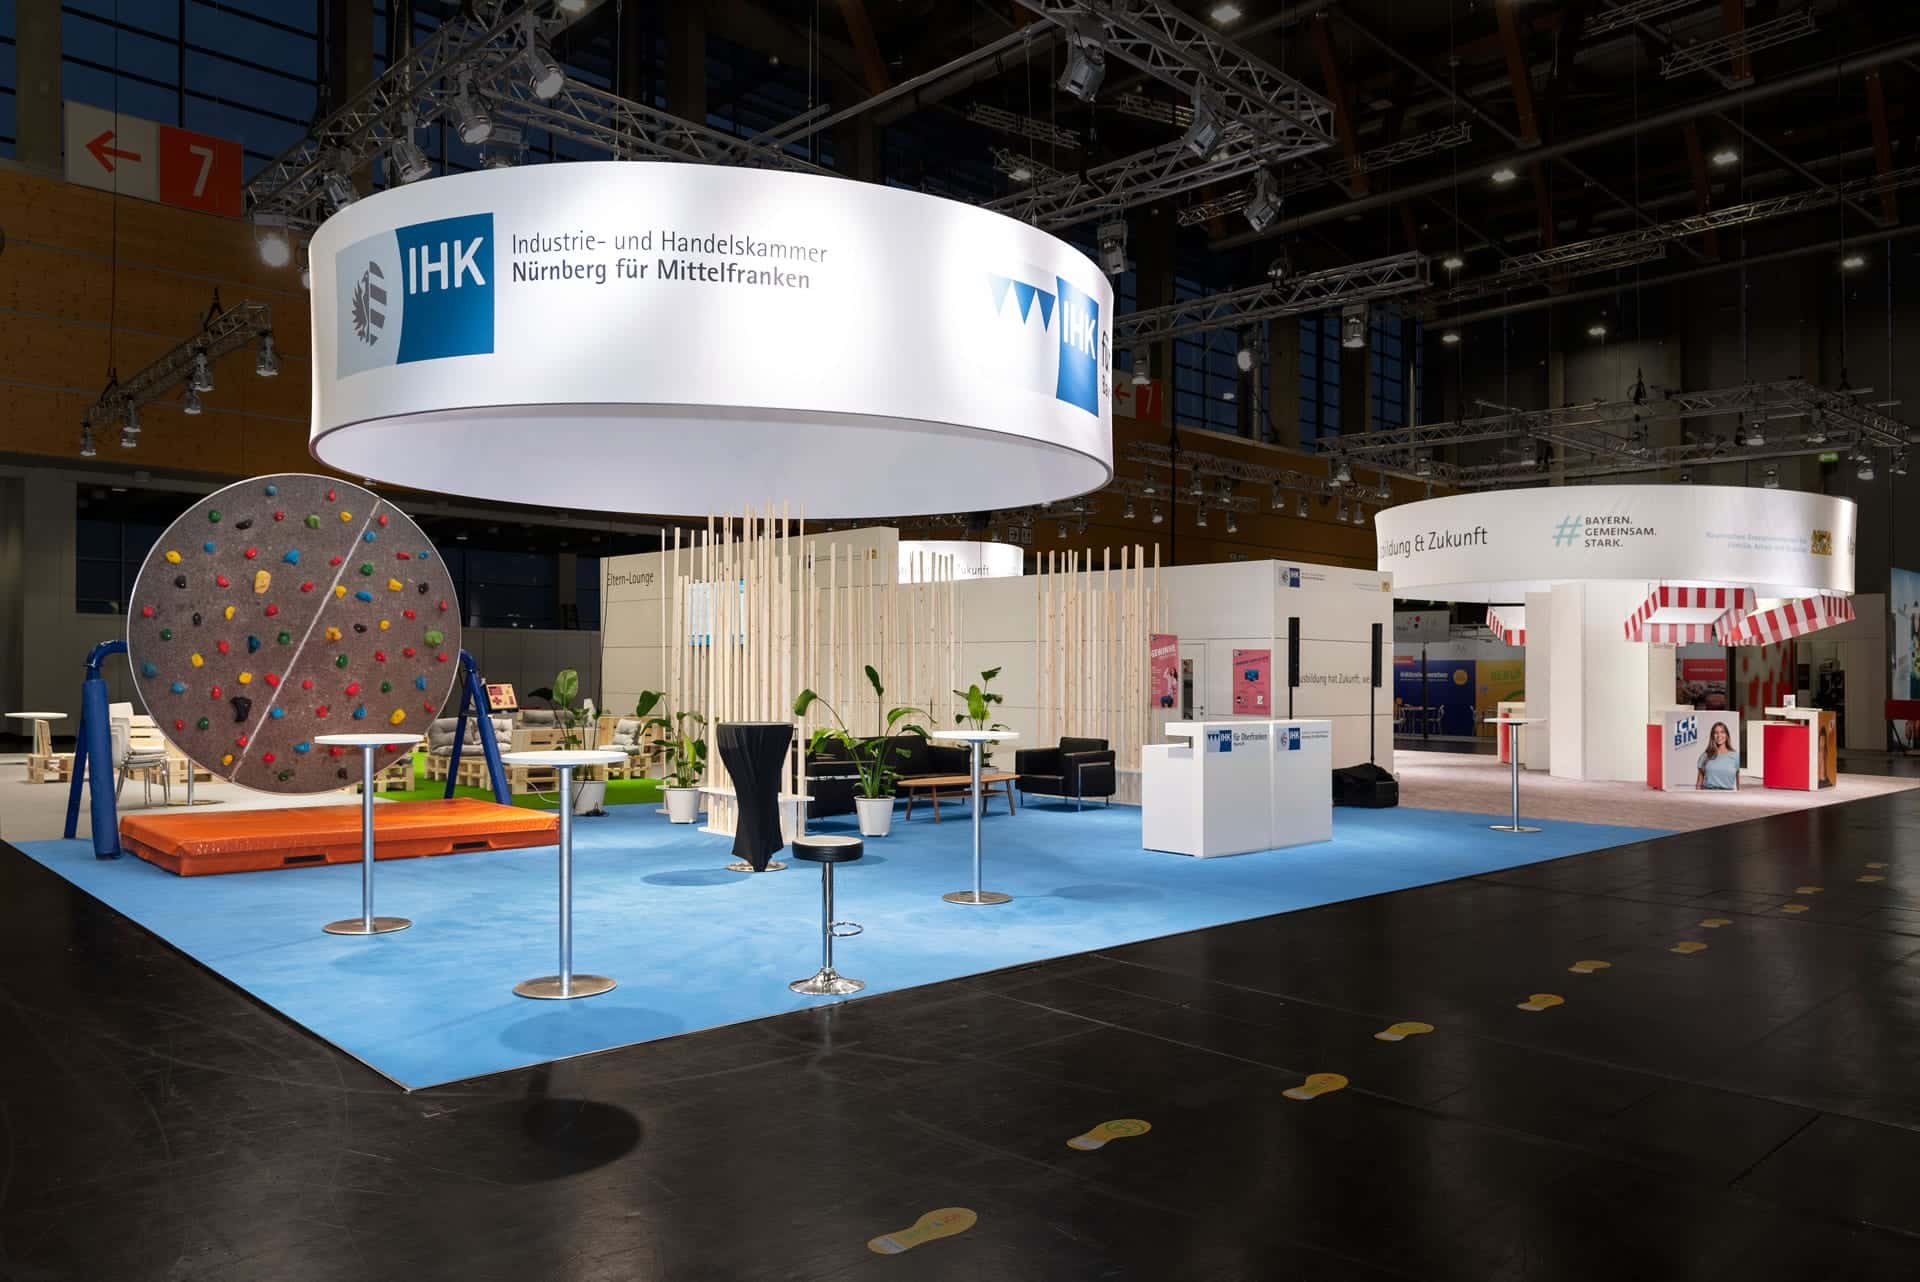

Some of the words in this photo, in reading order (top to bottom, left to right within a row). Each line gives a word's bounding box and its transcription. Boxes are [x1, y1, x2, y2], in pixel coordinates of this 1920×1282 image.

[189, 145, 216, 198] 7
[511, 230, 606, 255] Industrie-
[614, 231, 653, 252] und
[661, 231, 829, 264] Handelskammer
[407, 236, 487, 296] IHK
[511, 259, 607, 285] Nürnberg
[615, 258, 649, 280] für
[656, 258, 811, 290] Mittelfranken
[1063, 300, 1097, 361] IHK
[1428, 526, 1489, 551] Zukunft
[1585, 527, 1657, 538] GEMEINSAM.
[1585, 538, 1624, 548] STARK.
[607, 570, 655, 587] Eltern-Lounge
